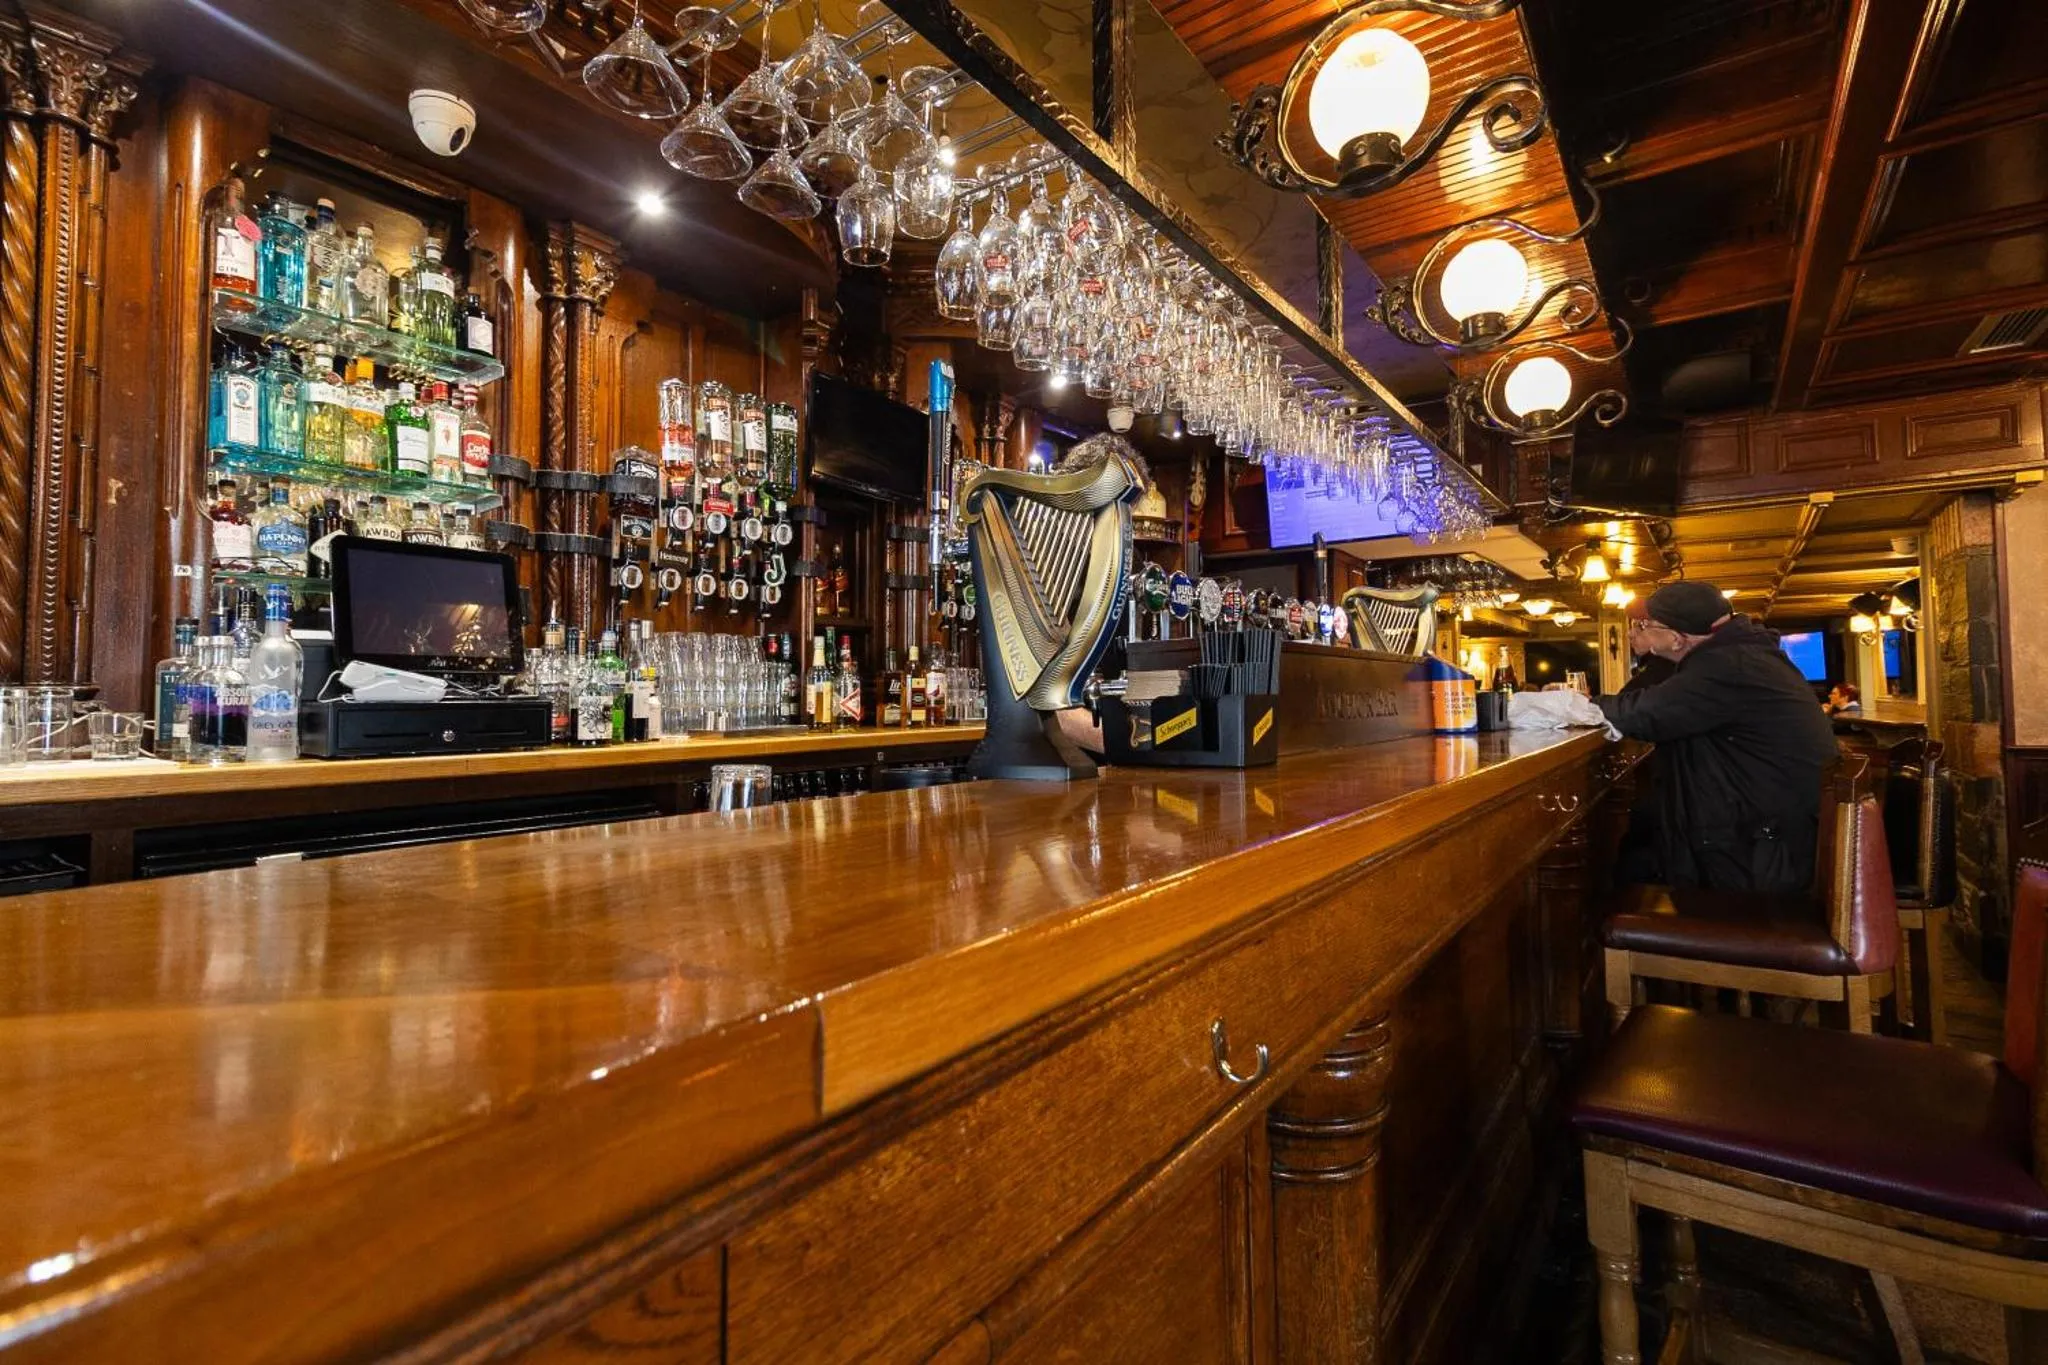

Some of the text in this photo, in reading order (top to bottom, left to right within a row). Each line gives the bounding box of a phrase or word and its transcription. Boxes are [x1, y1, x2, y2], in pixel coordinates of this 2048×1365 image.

[1112, 548, 1132, 620] GUINNESS
[992, 592, 1029, 682] GUINNESS
[215, 687, 249, 697] ABSOL
